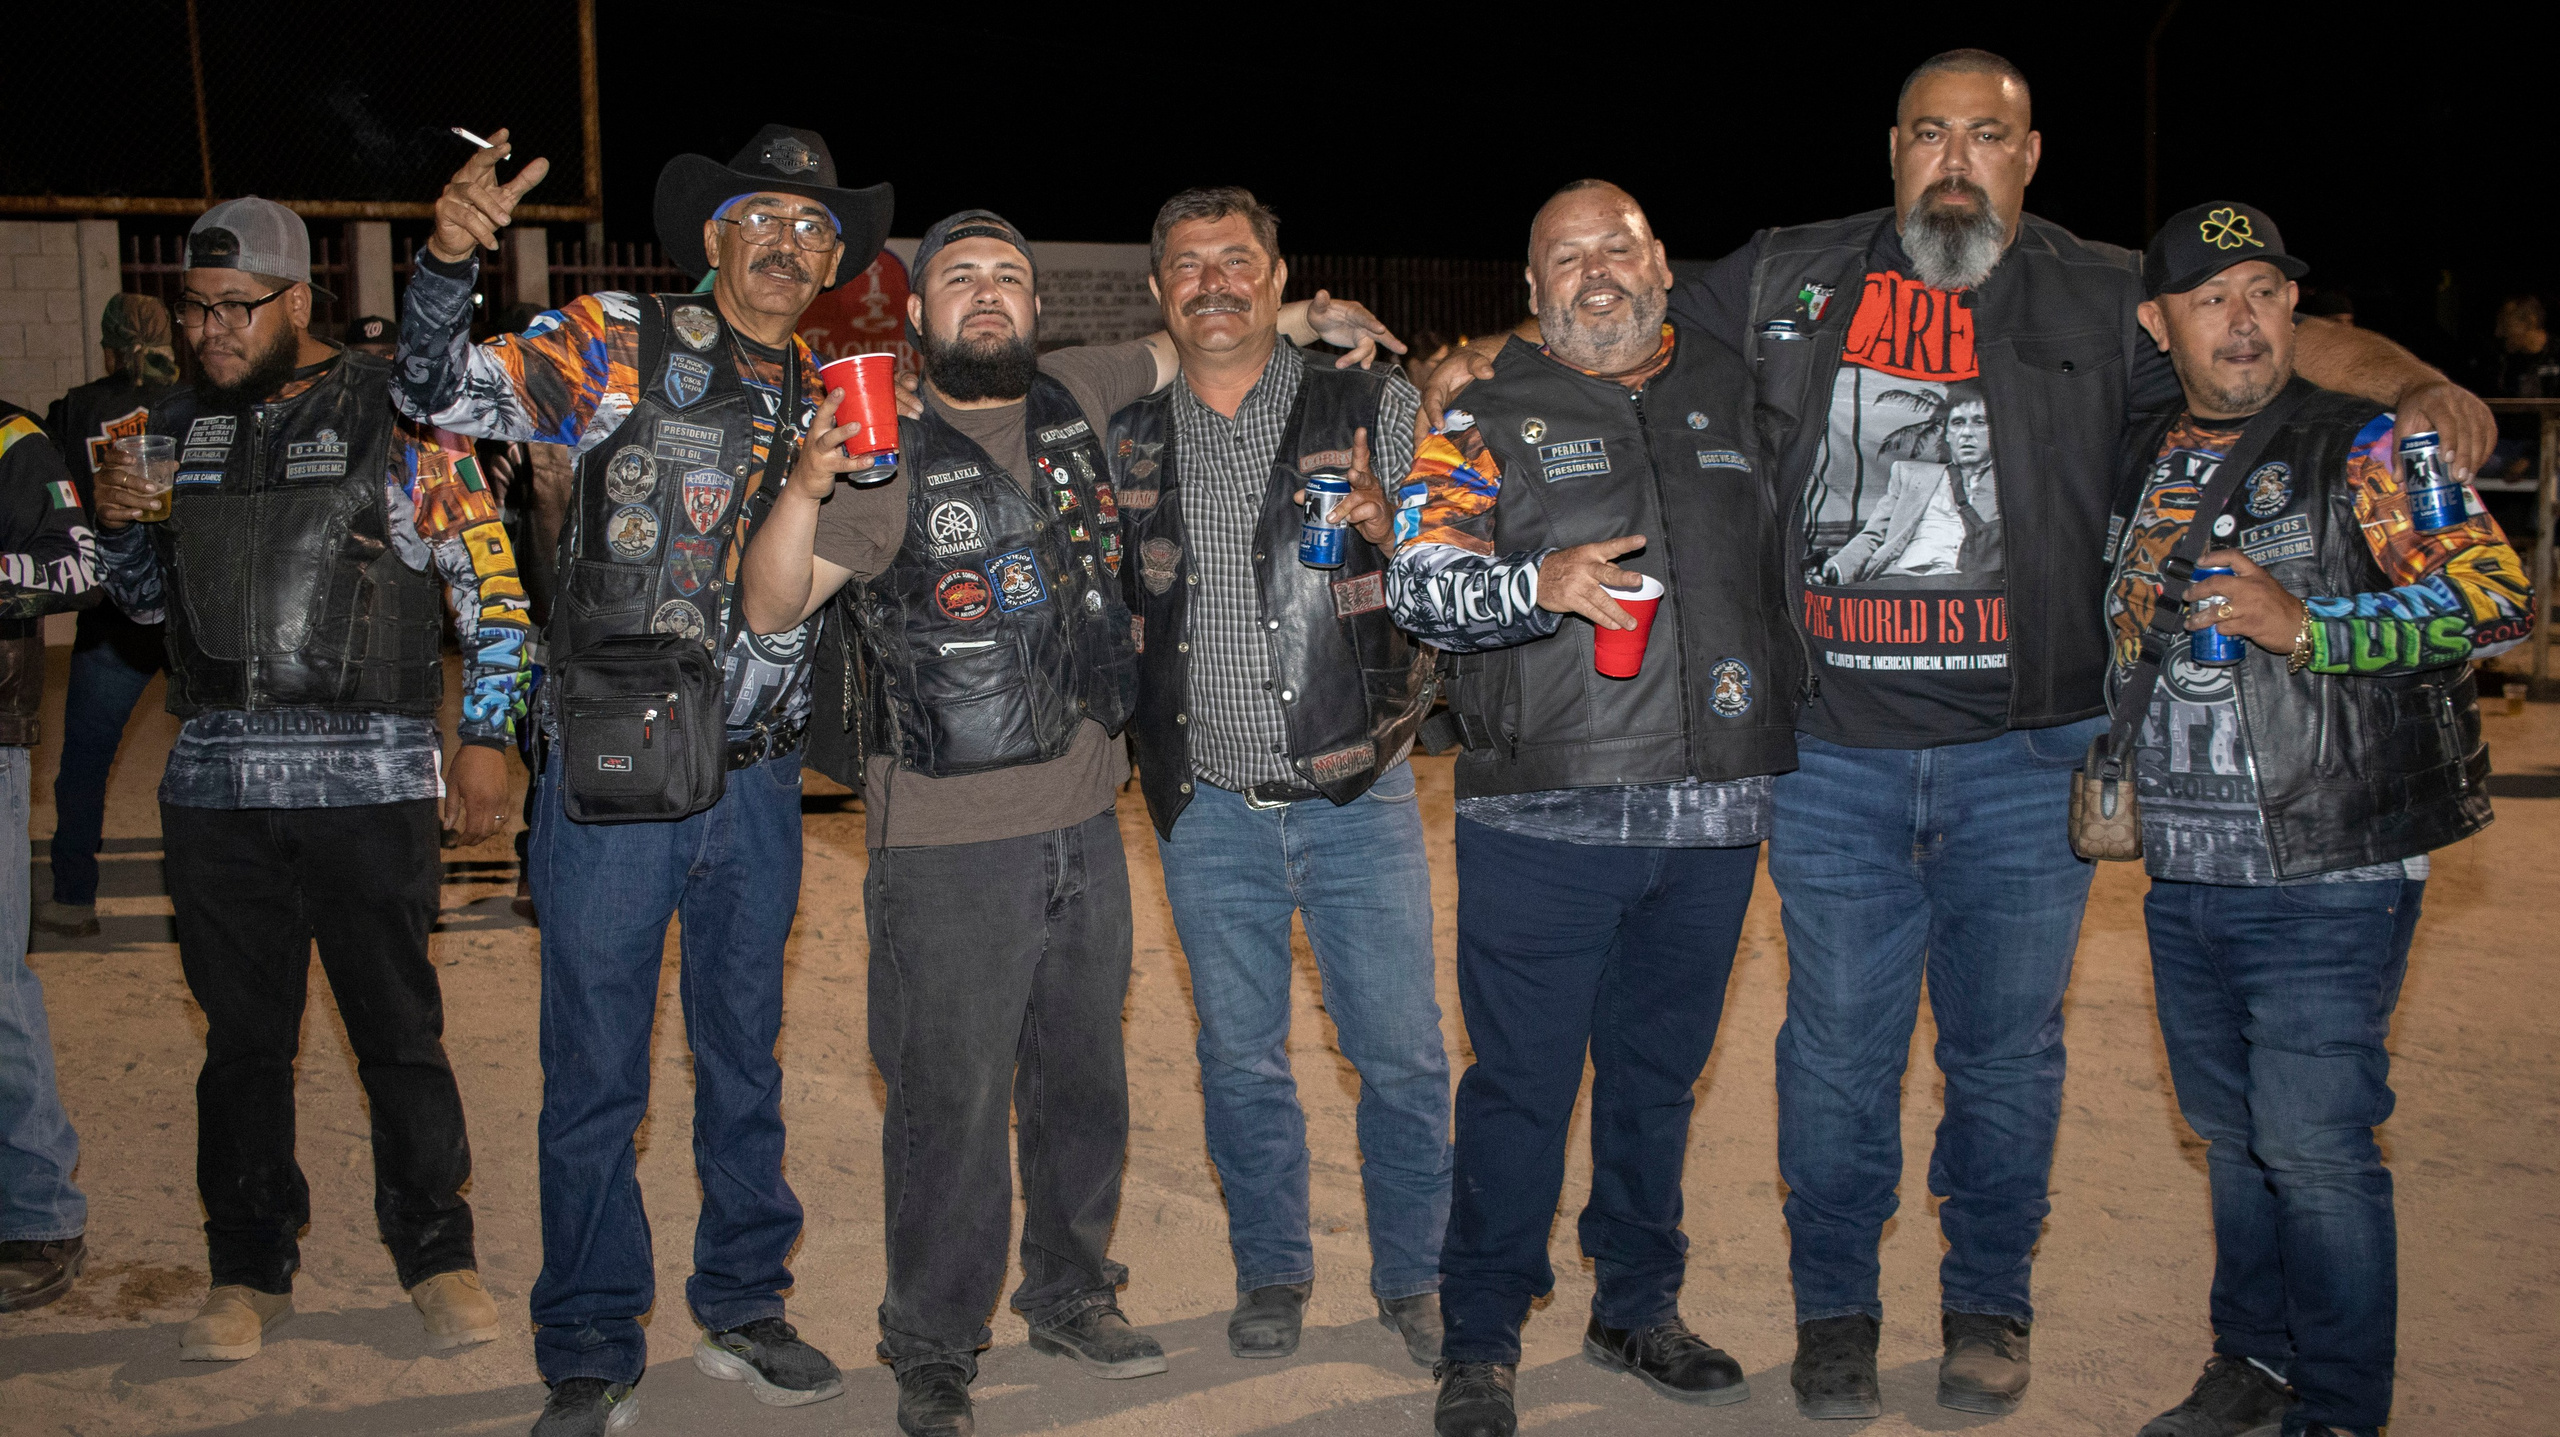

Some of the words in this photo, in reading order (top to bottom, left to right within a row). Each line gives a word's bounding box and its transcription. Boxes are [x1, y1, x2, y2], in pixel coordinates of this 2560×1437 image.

[663, 425, 719, 442] PRESIDENTE
[316, 444, 340, 453] POS
[671, 447, 686, 456] TIO
[687, 449, 702, 460] GIL
[1551, 442, 1593, 458] PERALTA
[289, 465, 307, 476] OSOS
[306, 464, 331, 473] VIEJOS
[927, 472, 954, 486] URIEL
[953, 466, 981, 481] AYALA
[1548, 461, 1606, 478] PRESIDENTE
[695, 473, 725, 486] MEXICO
[2411, 485, 2458, 512] ECATE
[2273, 519, 2300, 534] POS
[934, 537, 983, 556] YAMAHA
[2248, 551, 2267, 562] SOS
[2266, 543, 2295, 558] VIEJOS
[1804, 590, 1833, 640] THE
[1838, 597, 1928, 644] WORLD
[1937, 599, 1965, 644] IS
[2308, 616, 2472, 673] LUIS
[1834, 652, 1854, 668] LOVED
[1854, 655, 1871, 669] THE
[1872, 656, 1911, 670] AMERICAN
[1944, 655, 1968, 669] WITH
[1968, 655, 1975, 669] A
[246, 712, 371, 736] COLORADO
